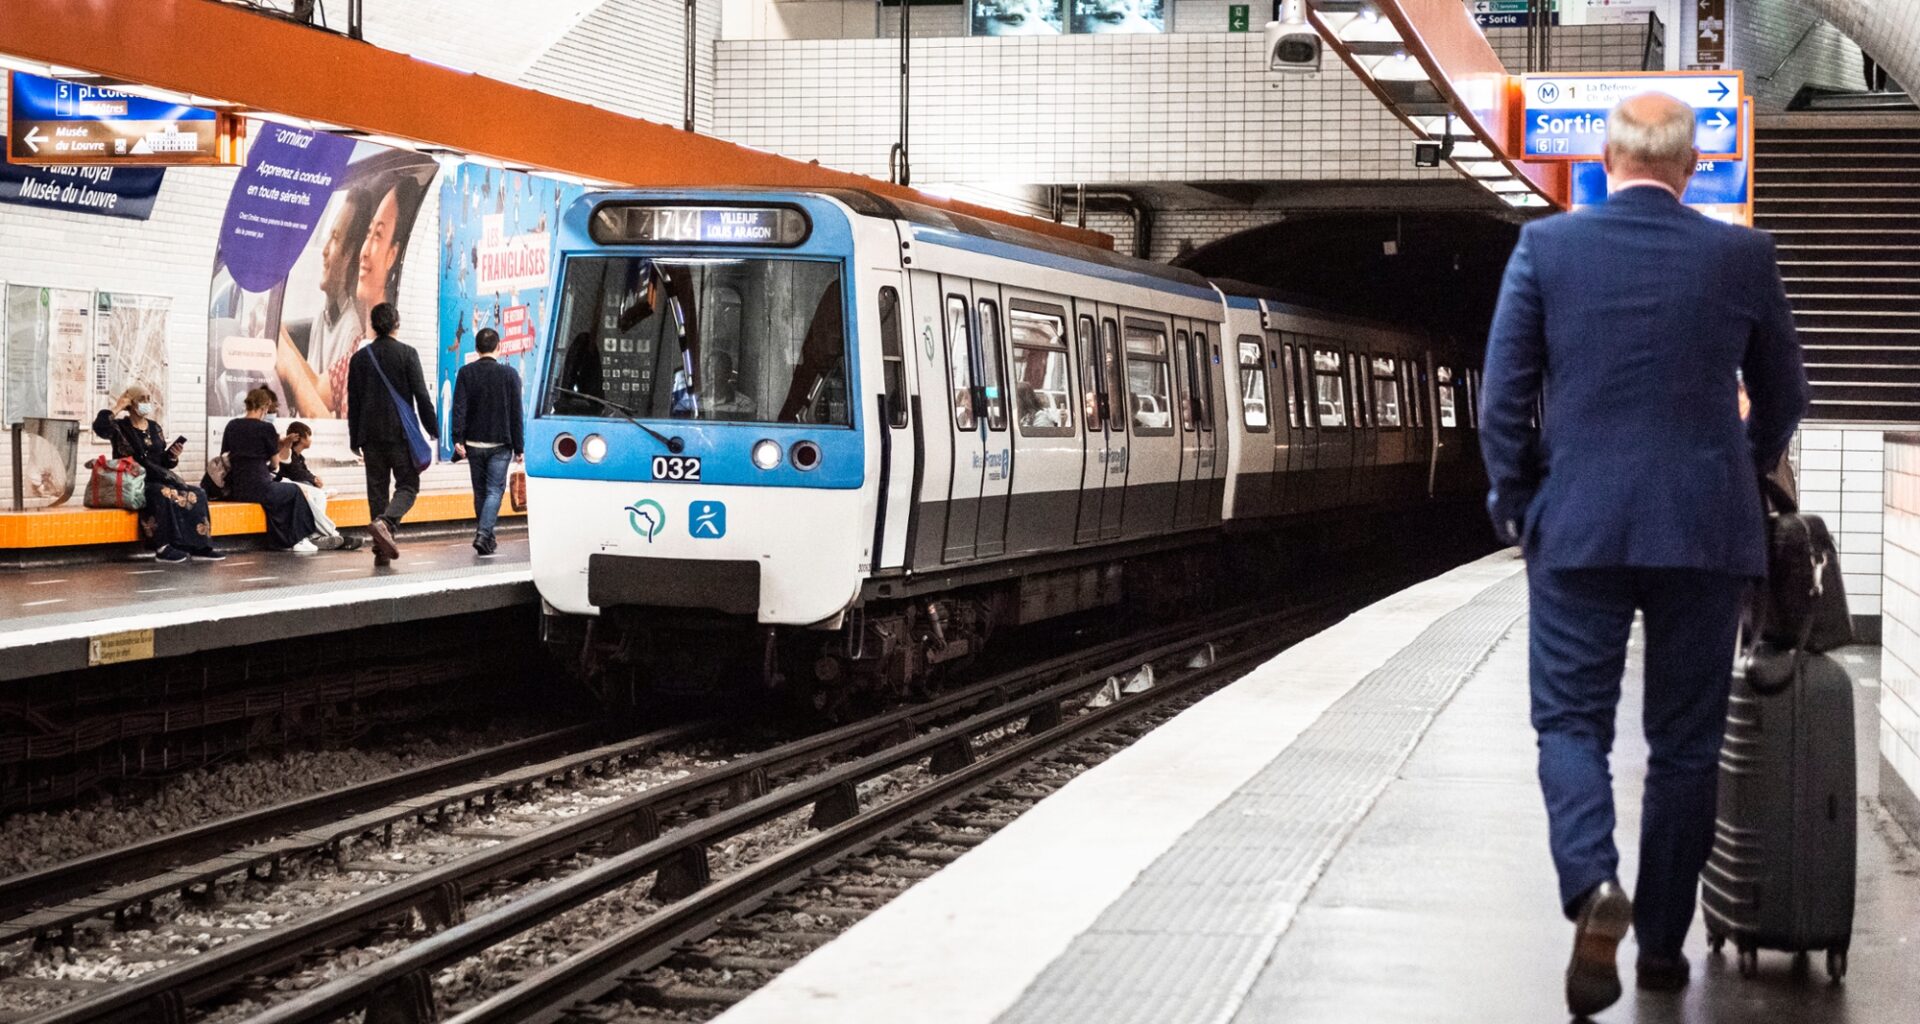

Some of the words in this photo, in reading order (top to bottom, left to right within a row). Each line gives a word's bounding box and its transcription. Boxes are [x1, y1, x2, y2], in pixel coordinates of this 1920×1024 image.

[1488, 14, 1517, 24] Sortie
[59, 85, 69, 98] 5
[79, 86, 95, 101] pl.
[1569, 87, 1576, 98] 1
[1536, 113, 1606, 135] Sortie
[55, 126, 88, 137] Musée
[55, 140, 69, 150] du
[71, 141, 105, 151] Louvre
[256, 160, 294, 179] Apprenez
[293, 168, 300, 181] à
[300, 172, 332, 186] conduire
[19, 177, 60, 201] Musée
[61, 182, 78, 204] du
[78, 185, 118, 209] Louvre
[247, 185, 258, 196] en
[259, 185, 280, 200] toute
[720, 212, 758, 225] VILLEJUIF
[487, 227, 499, 248] LES
[706, 225, 734, 238] LOUIS
[735, 226, 772, 239] ARAGON
[652, 457, 700, 480] 032
